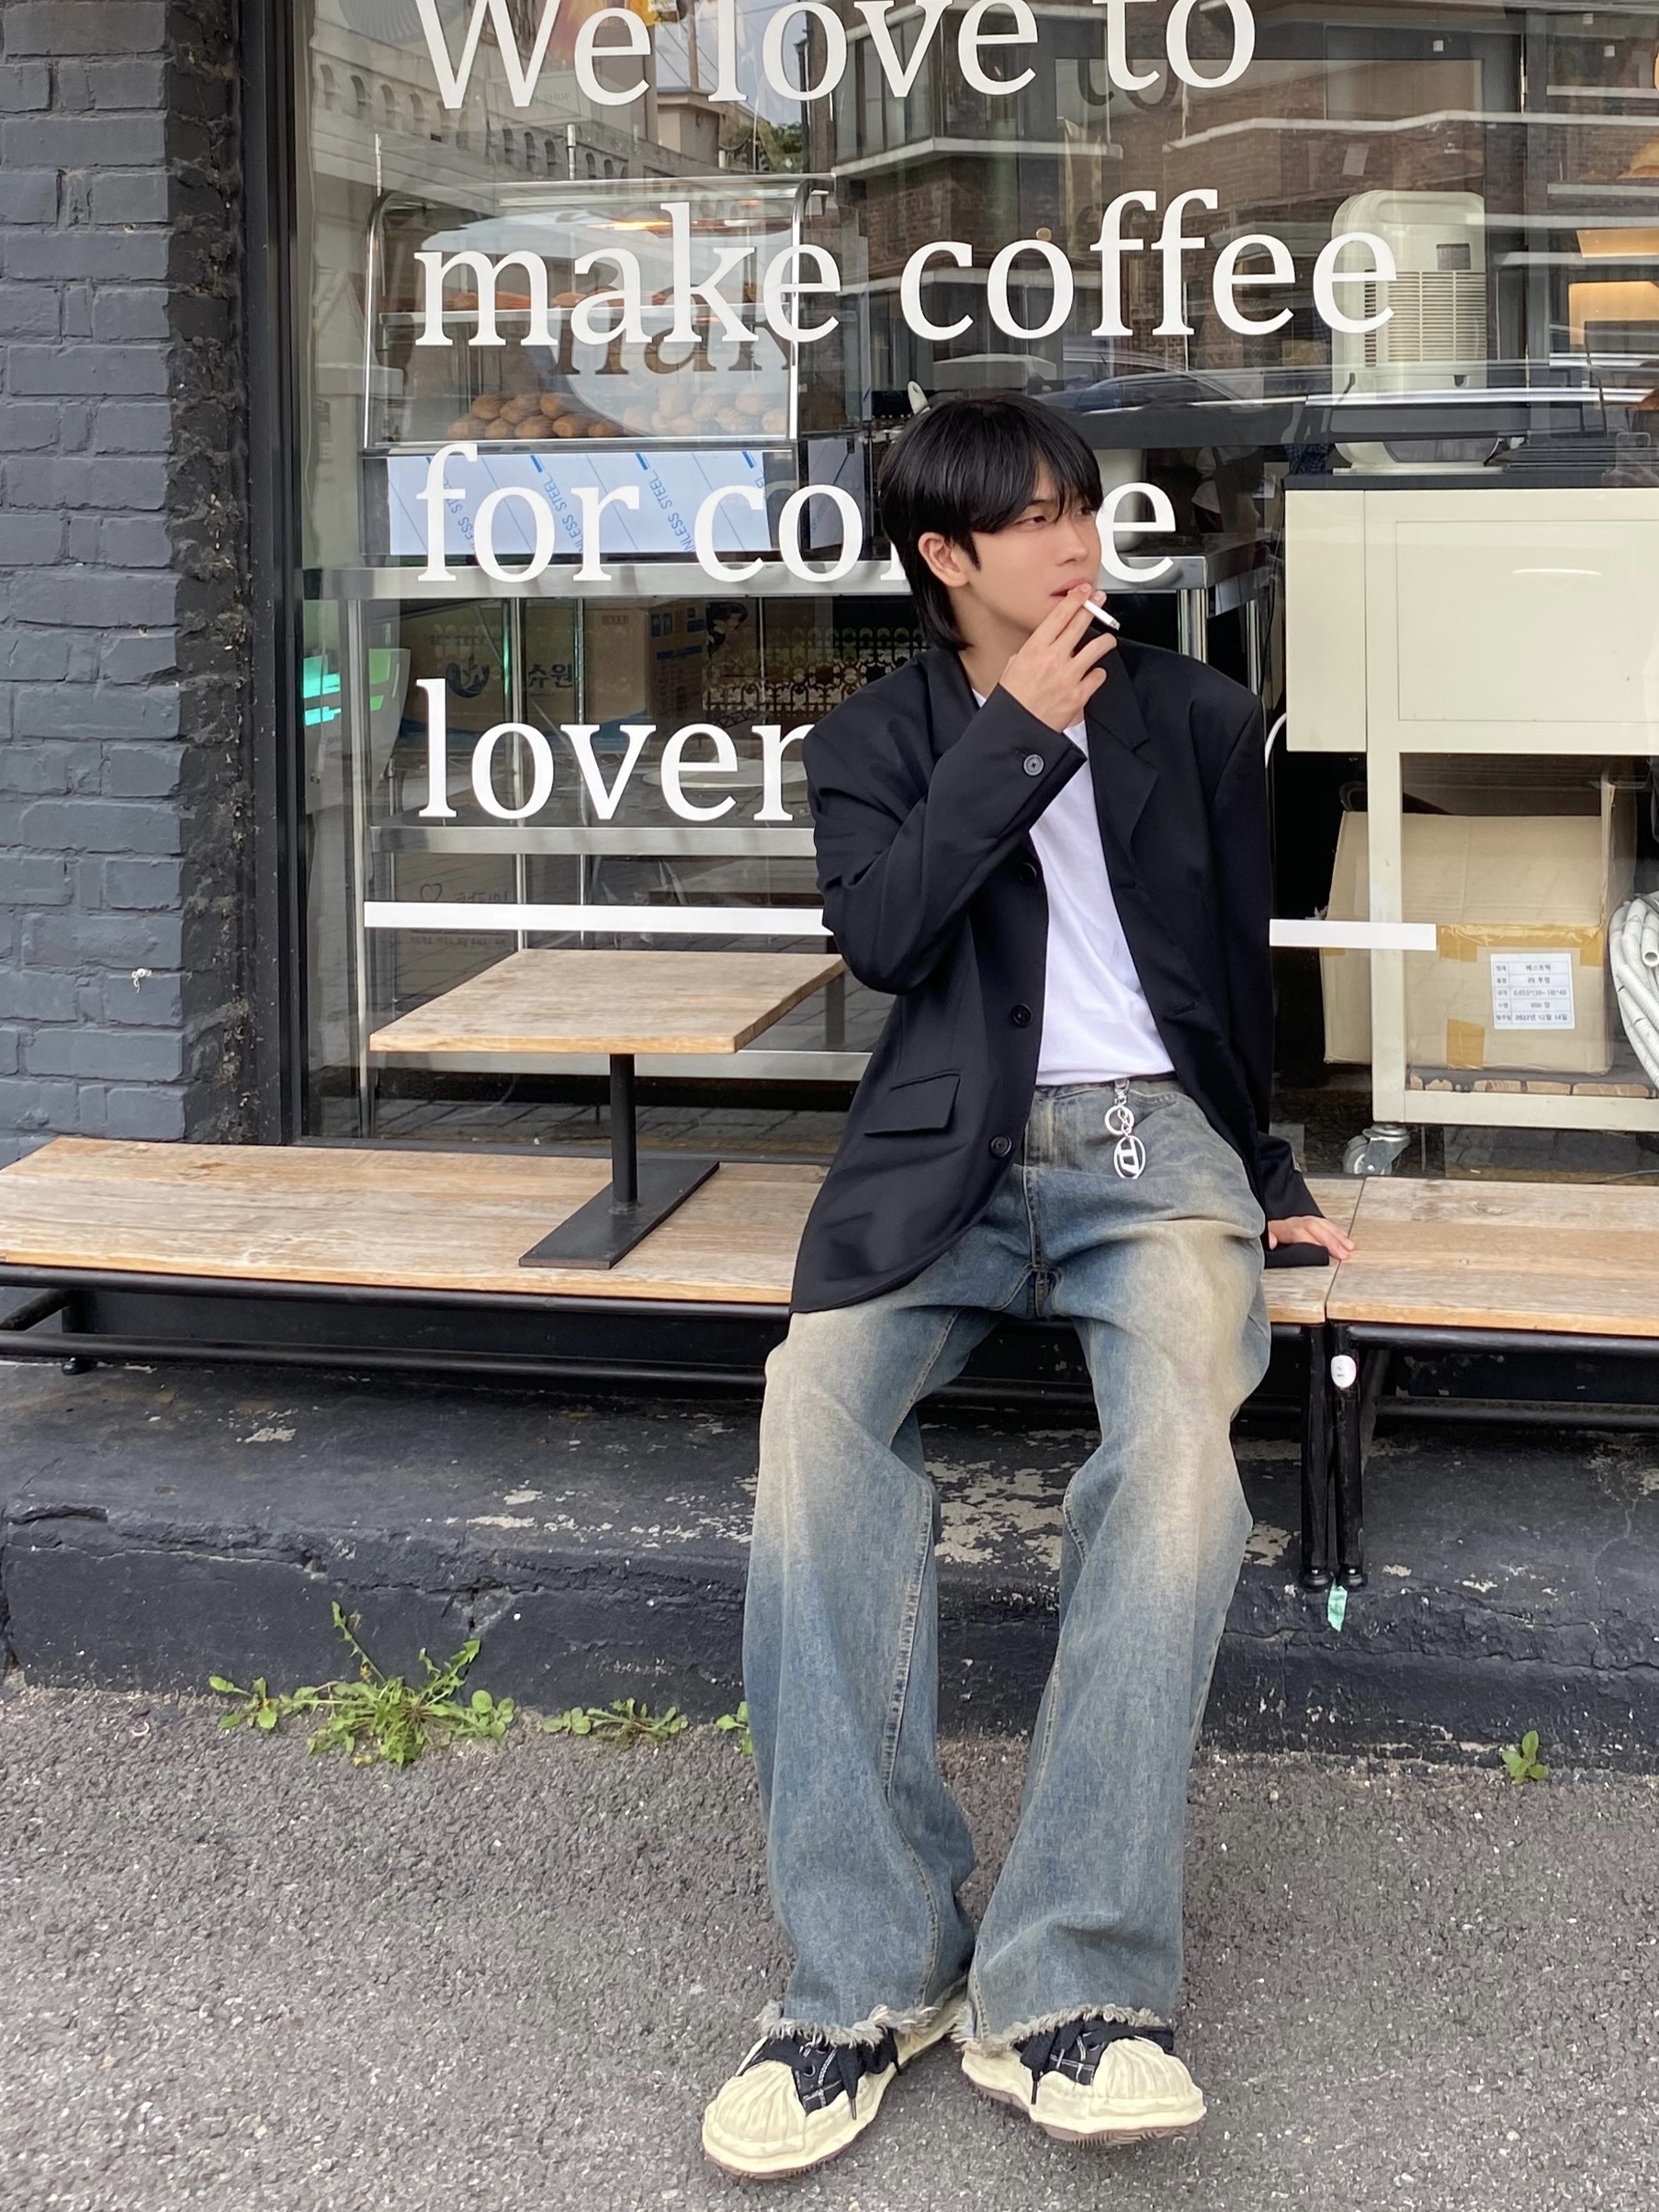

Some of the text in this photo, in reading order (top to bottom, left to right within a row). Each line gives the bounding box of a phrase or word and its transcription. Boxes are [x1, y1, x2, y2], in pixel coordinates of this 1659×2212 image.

[415, 0, 1255, 109] We love to
[414, 188, 1398, 346] make coffee
[416, 443, 1177, 583] for coe
[648, 470, 672, 510] STEEL
[416, 679, 816, 820] lover
